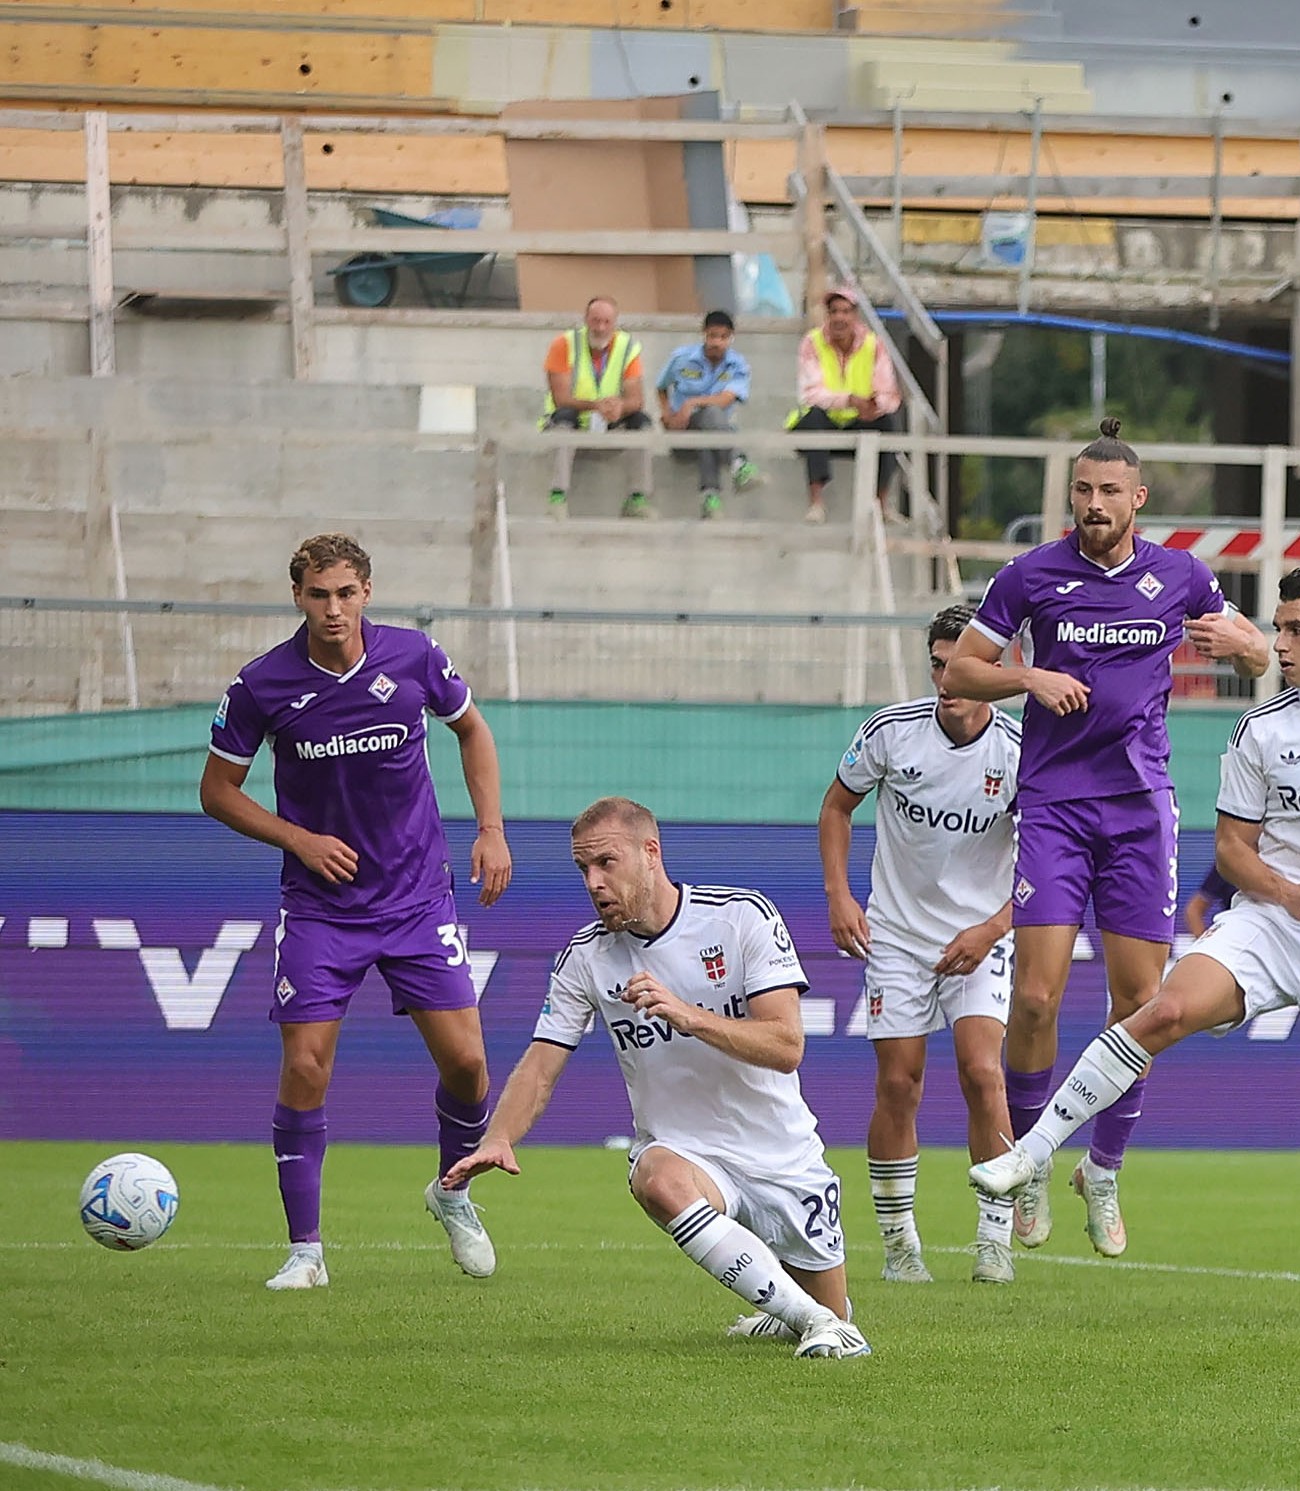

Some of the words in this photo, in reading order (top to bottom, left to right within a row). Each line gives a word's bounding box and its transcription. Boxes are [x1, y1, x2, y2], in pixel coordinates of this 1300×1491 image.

[1057, 620, 1160, 645] Mediacom
[296, 732, 400, 760] Mediacom
[1067, 1076, 1098, 1106] COMO
[801, 1182, 839, 1240] 28
[720, 1252, 753, 1289] COMO
